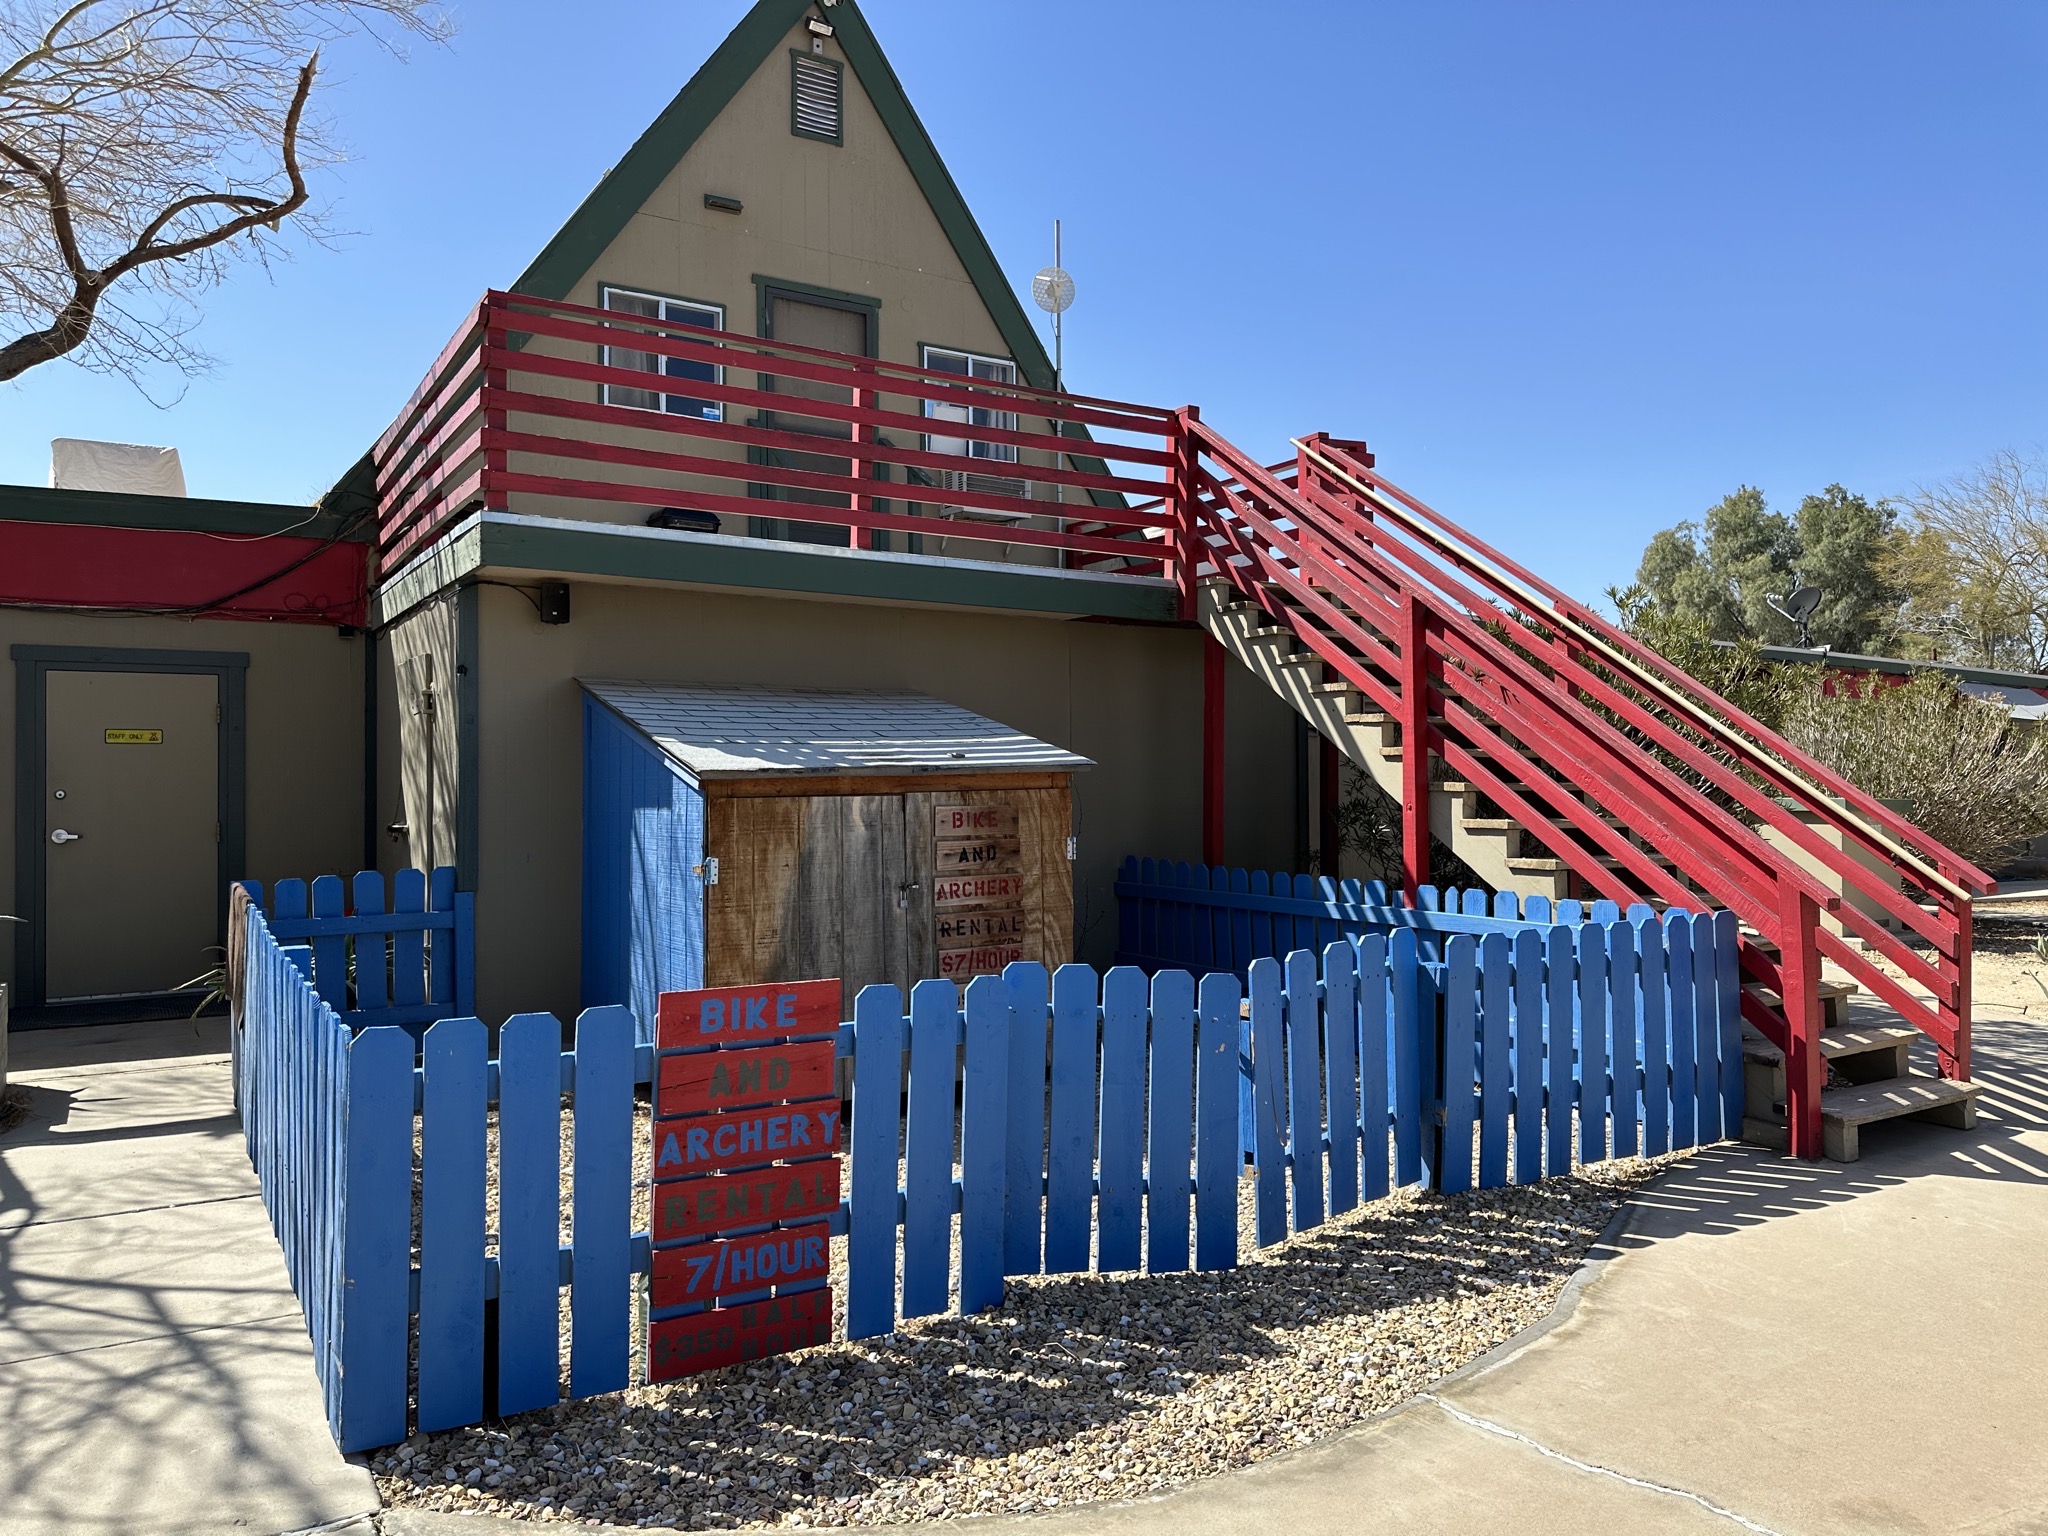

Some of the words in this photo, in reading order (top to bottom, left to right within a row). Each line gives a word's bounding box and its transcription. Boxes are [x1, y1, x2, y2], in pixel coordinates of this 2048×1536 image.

[952, 811, 998, 829] BIKE
[958, 844, 997, 863] AND
[936, 877, 1022, 901] ARCHERY
[940, 917, 1022, 938] RENTAL
[700, 994, 798, 1034] BIKE
[708, 1056, 791, 1098] AND
[657, 1111, 840, 1168] ARCHERY
[664, 1173, 833, 1230] RENTAL
[686, 1236, 825, 1294] 7/HOUR
[741, 1292, 830, 1330] HALF
[741, 1323, 829, 1361] HOUR
